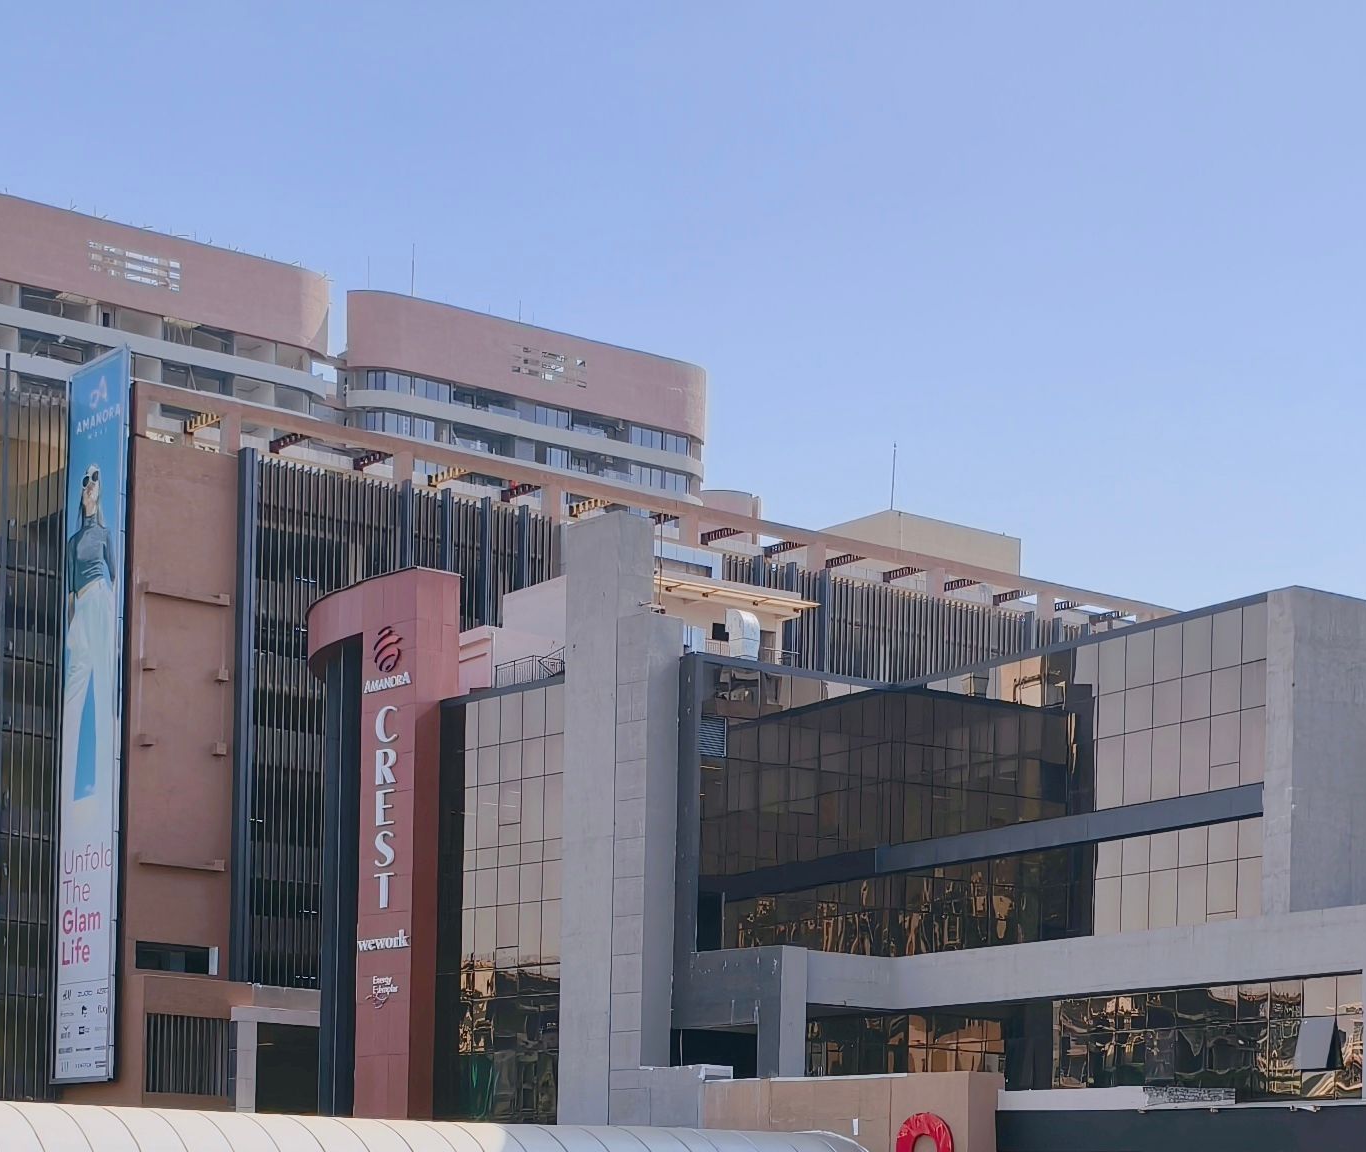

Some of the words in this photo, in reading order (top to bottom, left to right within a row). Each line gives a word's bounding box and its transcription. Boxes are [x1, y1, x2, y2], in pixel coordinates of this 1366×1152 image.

[76, 403, 121, 435] AMANORA
[363, 671, 412, 694] AMANORA
[373, 705, 400, 910] CREST
[63, 877, 91, 905] The
[62, 906, 101, 935] Glam
[61, 936, 91, 966] Life
[357, 929, 410, 952] wework
